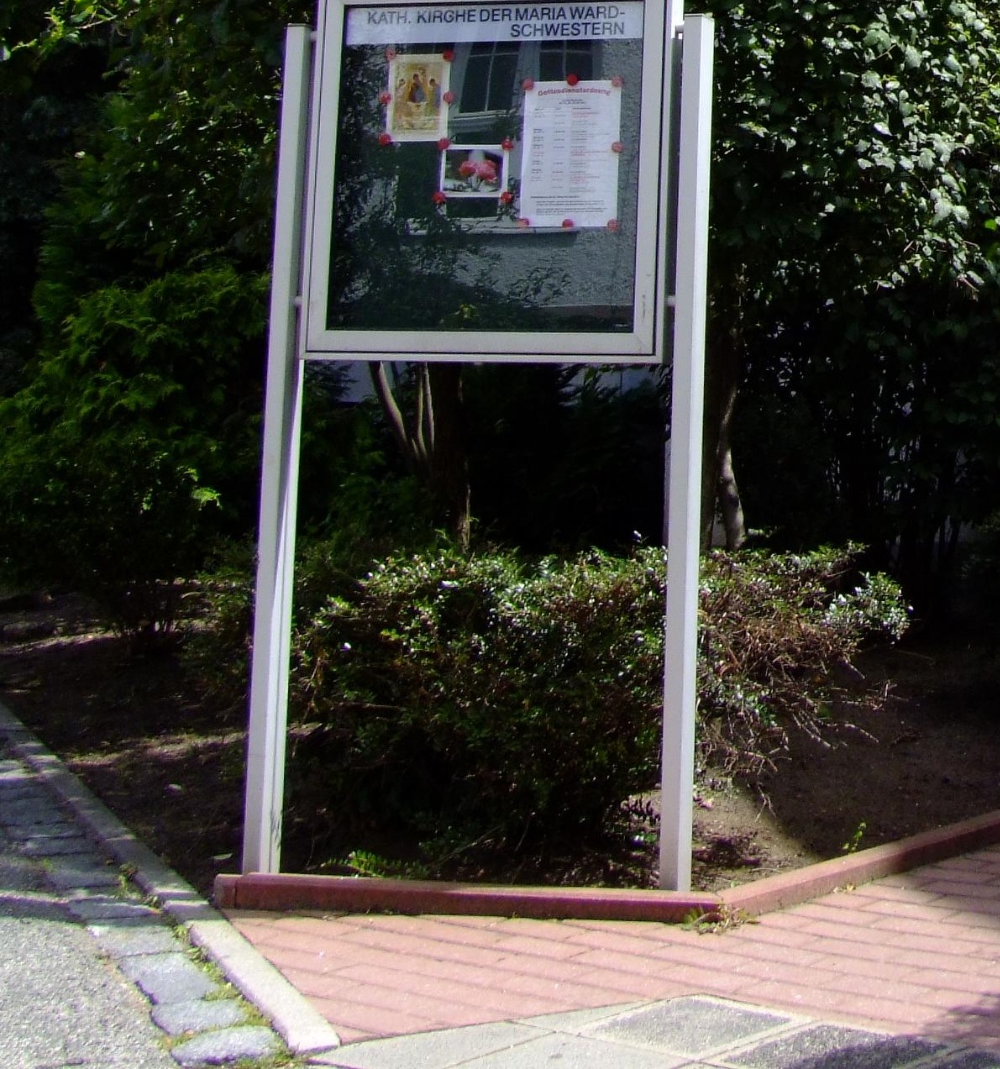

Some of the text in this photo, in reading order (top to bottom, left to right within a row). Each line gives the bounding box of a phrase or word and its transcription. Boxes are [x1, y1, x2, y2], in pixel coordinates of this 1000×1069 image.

[367, 11, 411, 24] KATH.
[480, 8, 511, 22] DER
[515, 7, 566, 21] MARIA
[570, 5, 625, 20] WARD-
[510, 22, 625, 37] SCHWESTERN
